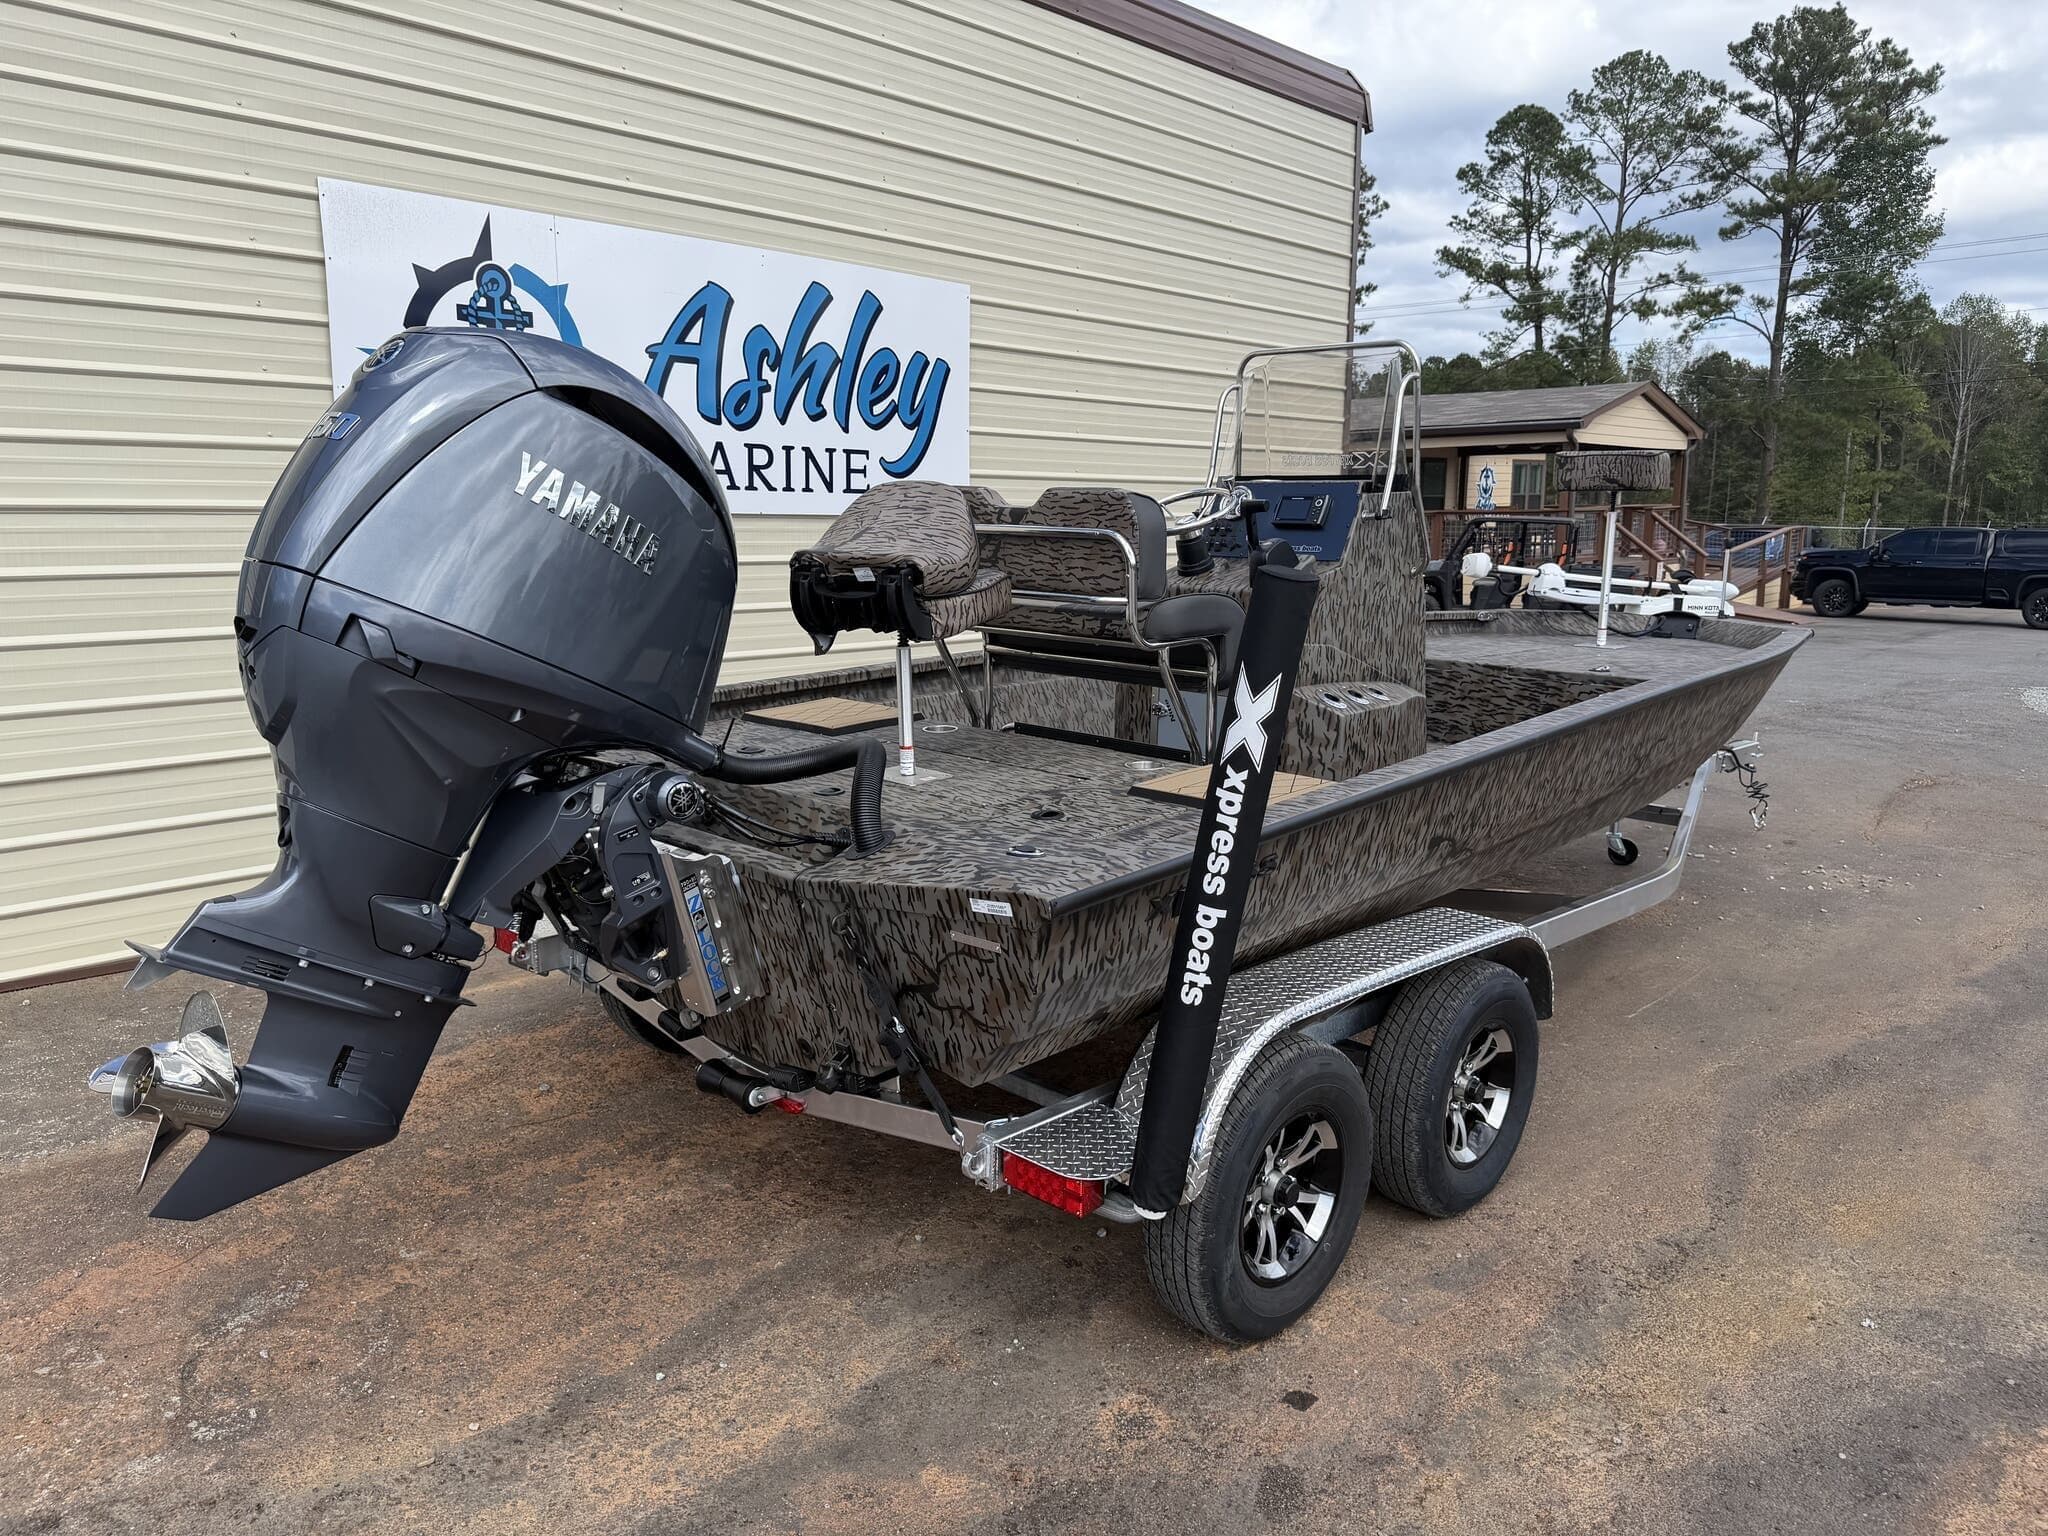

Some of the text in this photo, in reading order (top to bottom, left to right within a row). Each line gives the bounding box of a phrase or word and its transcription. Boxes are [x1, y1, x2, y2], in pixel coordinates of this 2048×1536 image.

[644, 280, 951, 479] Ashley
[514, 451, 661, 576] YAMAHA
[711, 441, 871, 494] ARINE
[1202, 764, 1249, 897] xpress
[1181, 903, 1228, 1007] boats
